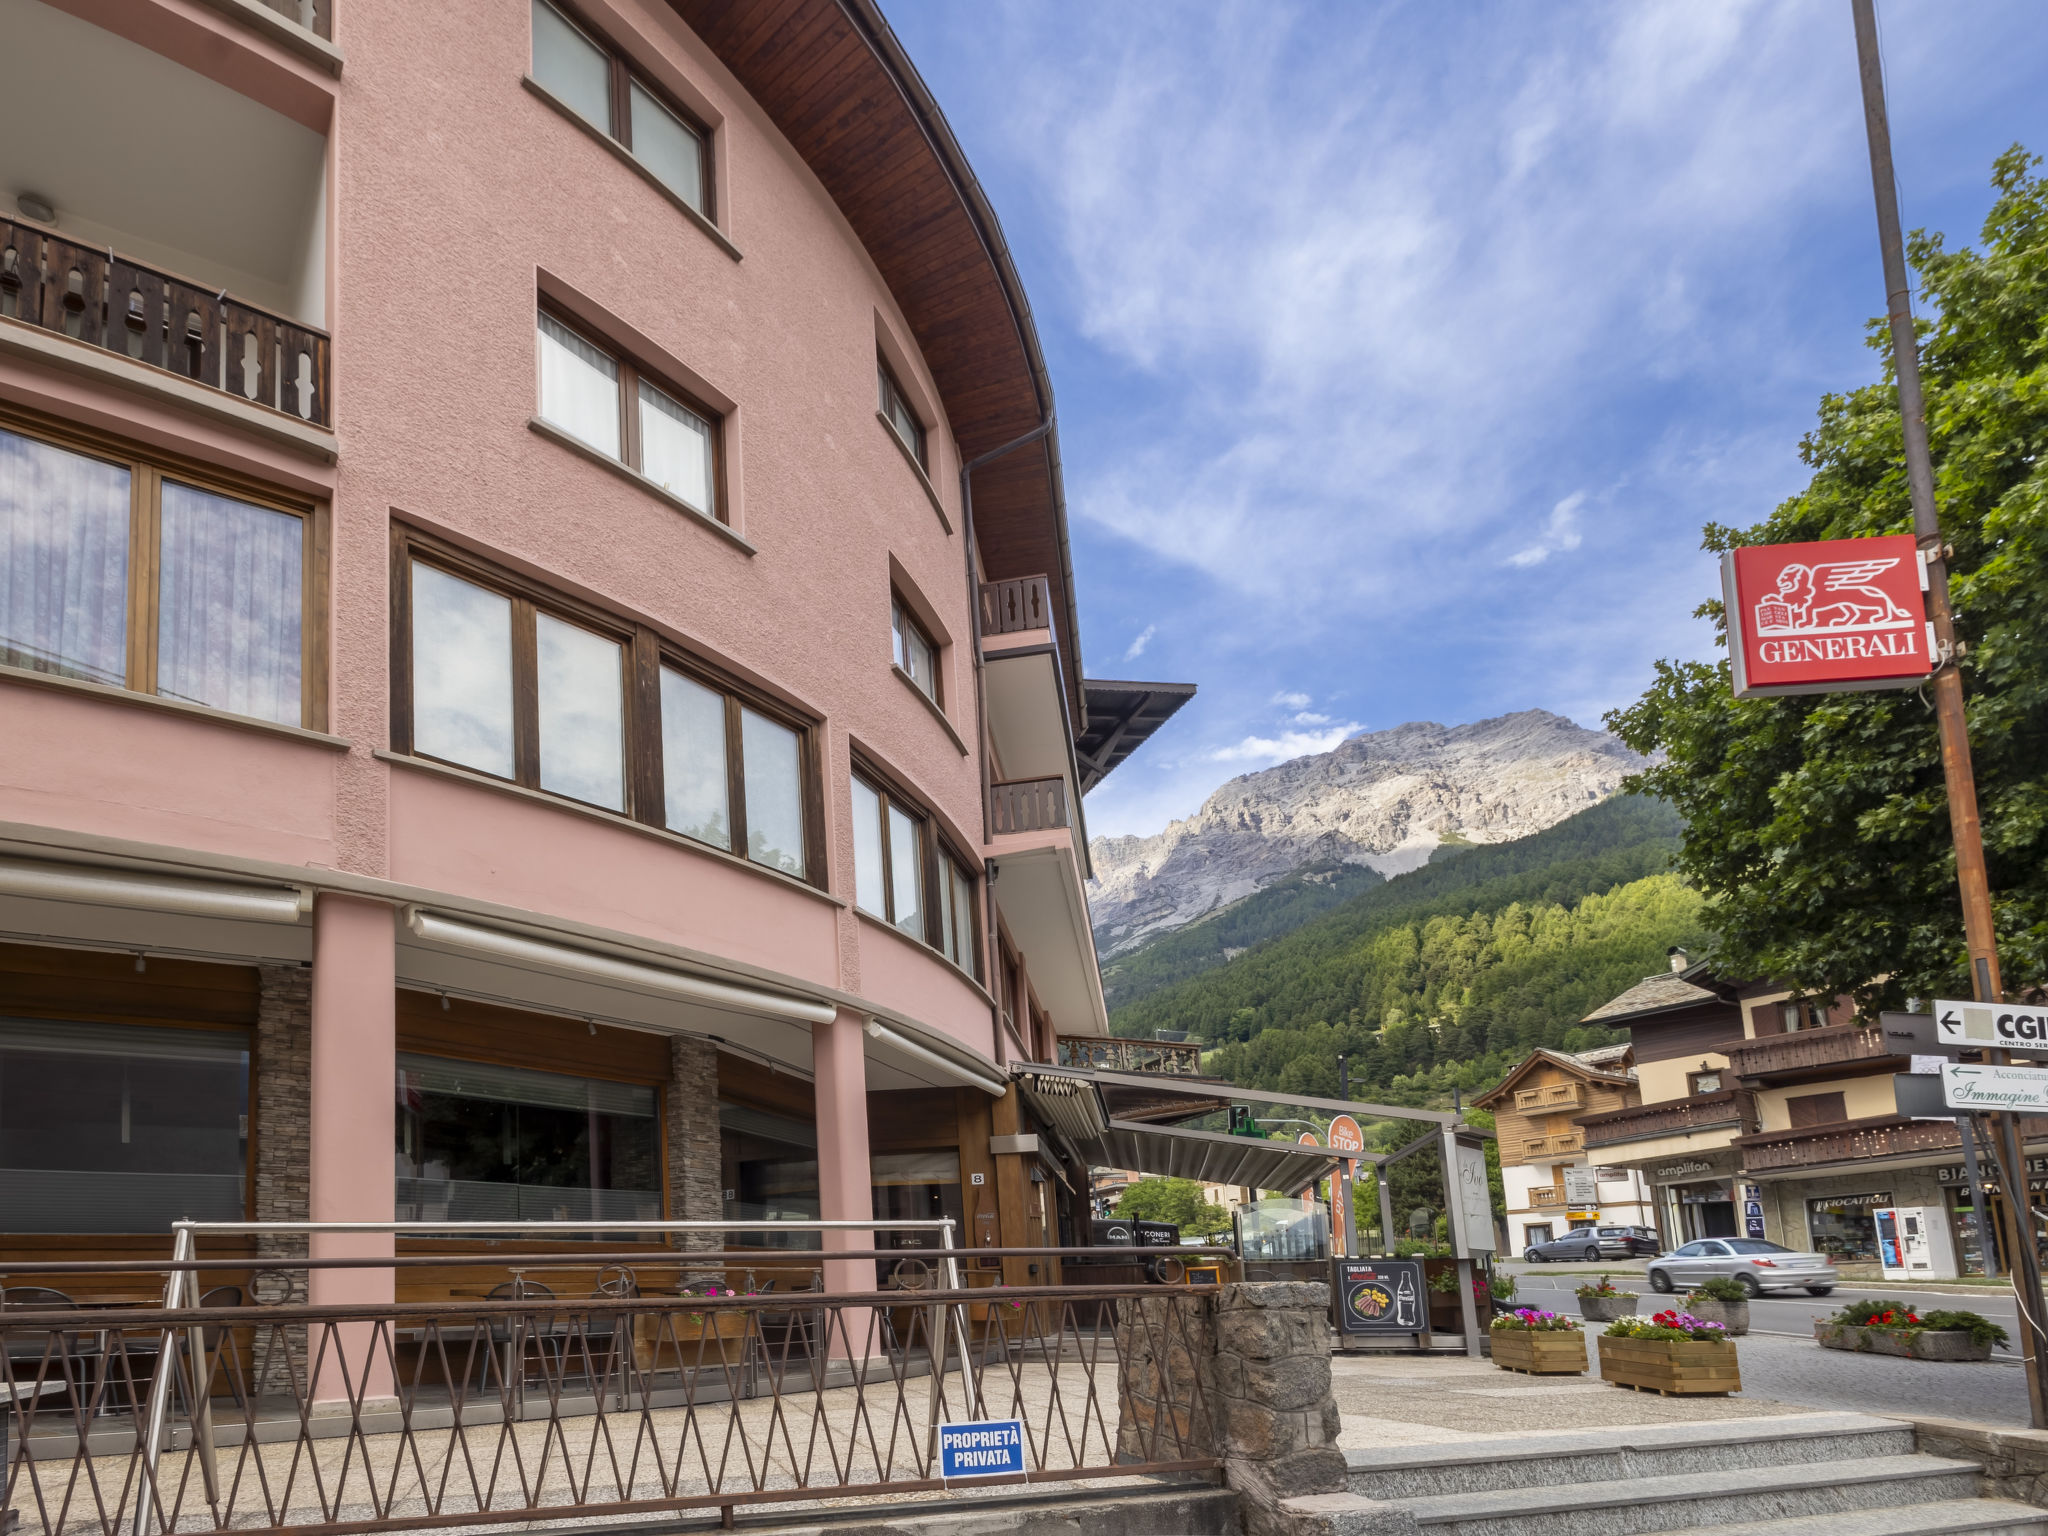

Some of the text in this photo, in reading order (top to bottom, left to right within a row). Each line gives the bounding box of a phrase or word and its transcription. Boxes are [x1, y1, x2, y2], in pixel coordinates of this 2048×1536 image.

[1759, 632, 1918, 664] GENERALI
[1996, 1013, 2048, 1040] CGI
[1999, 1040, 2031, 1048] CENTRO
[1952, 1081, 2040, 1109] Immagine
[1338, 1125, 1354, 1139] Bike
[1333, 1135, 1359, 1152] STOP
[1657, 1162, 1711, 1177] amplifon
[973, 1174, 982, 1183] 8
[1346, 1265, 1373, 1273] TAGLIATA
[943, 1425, 1019, 1449] PROPRIETÀ
[954, 1448, 1011, 1468] PRIVATA
